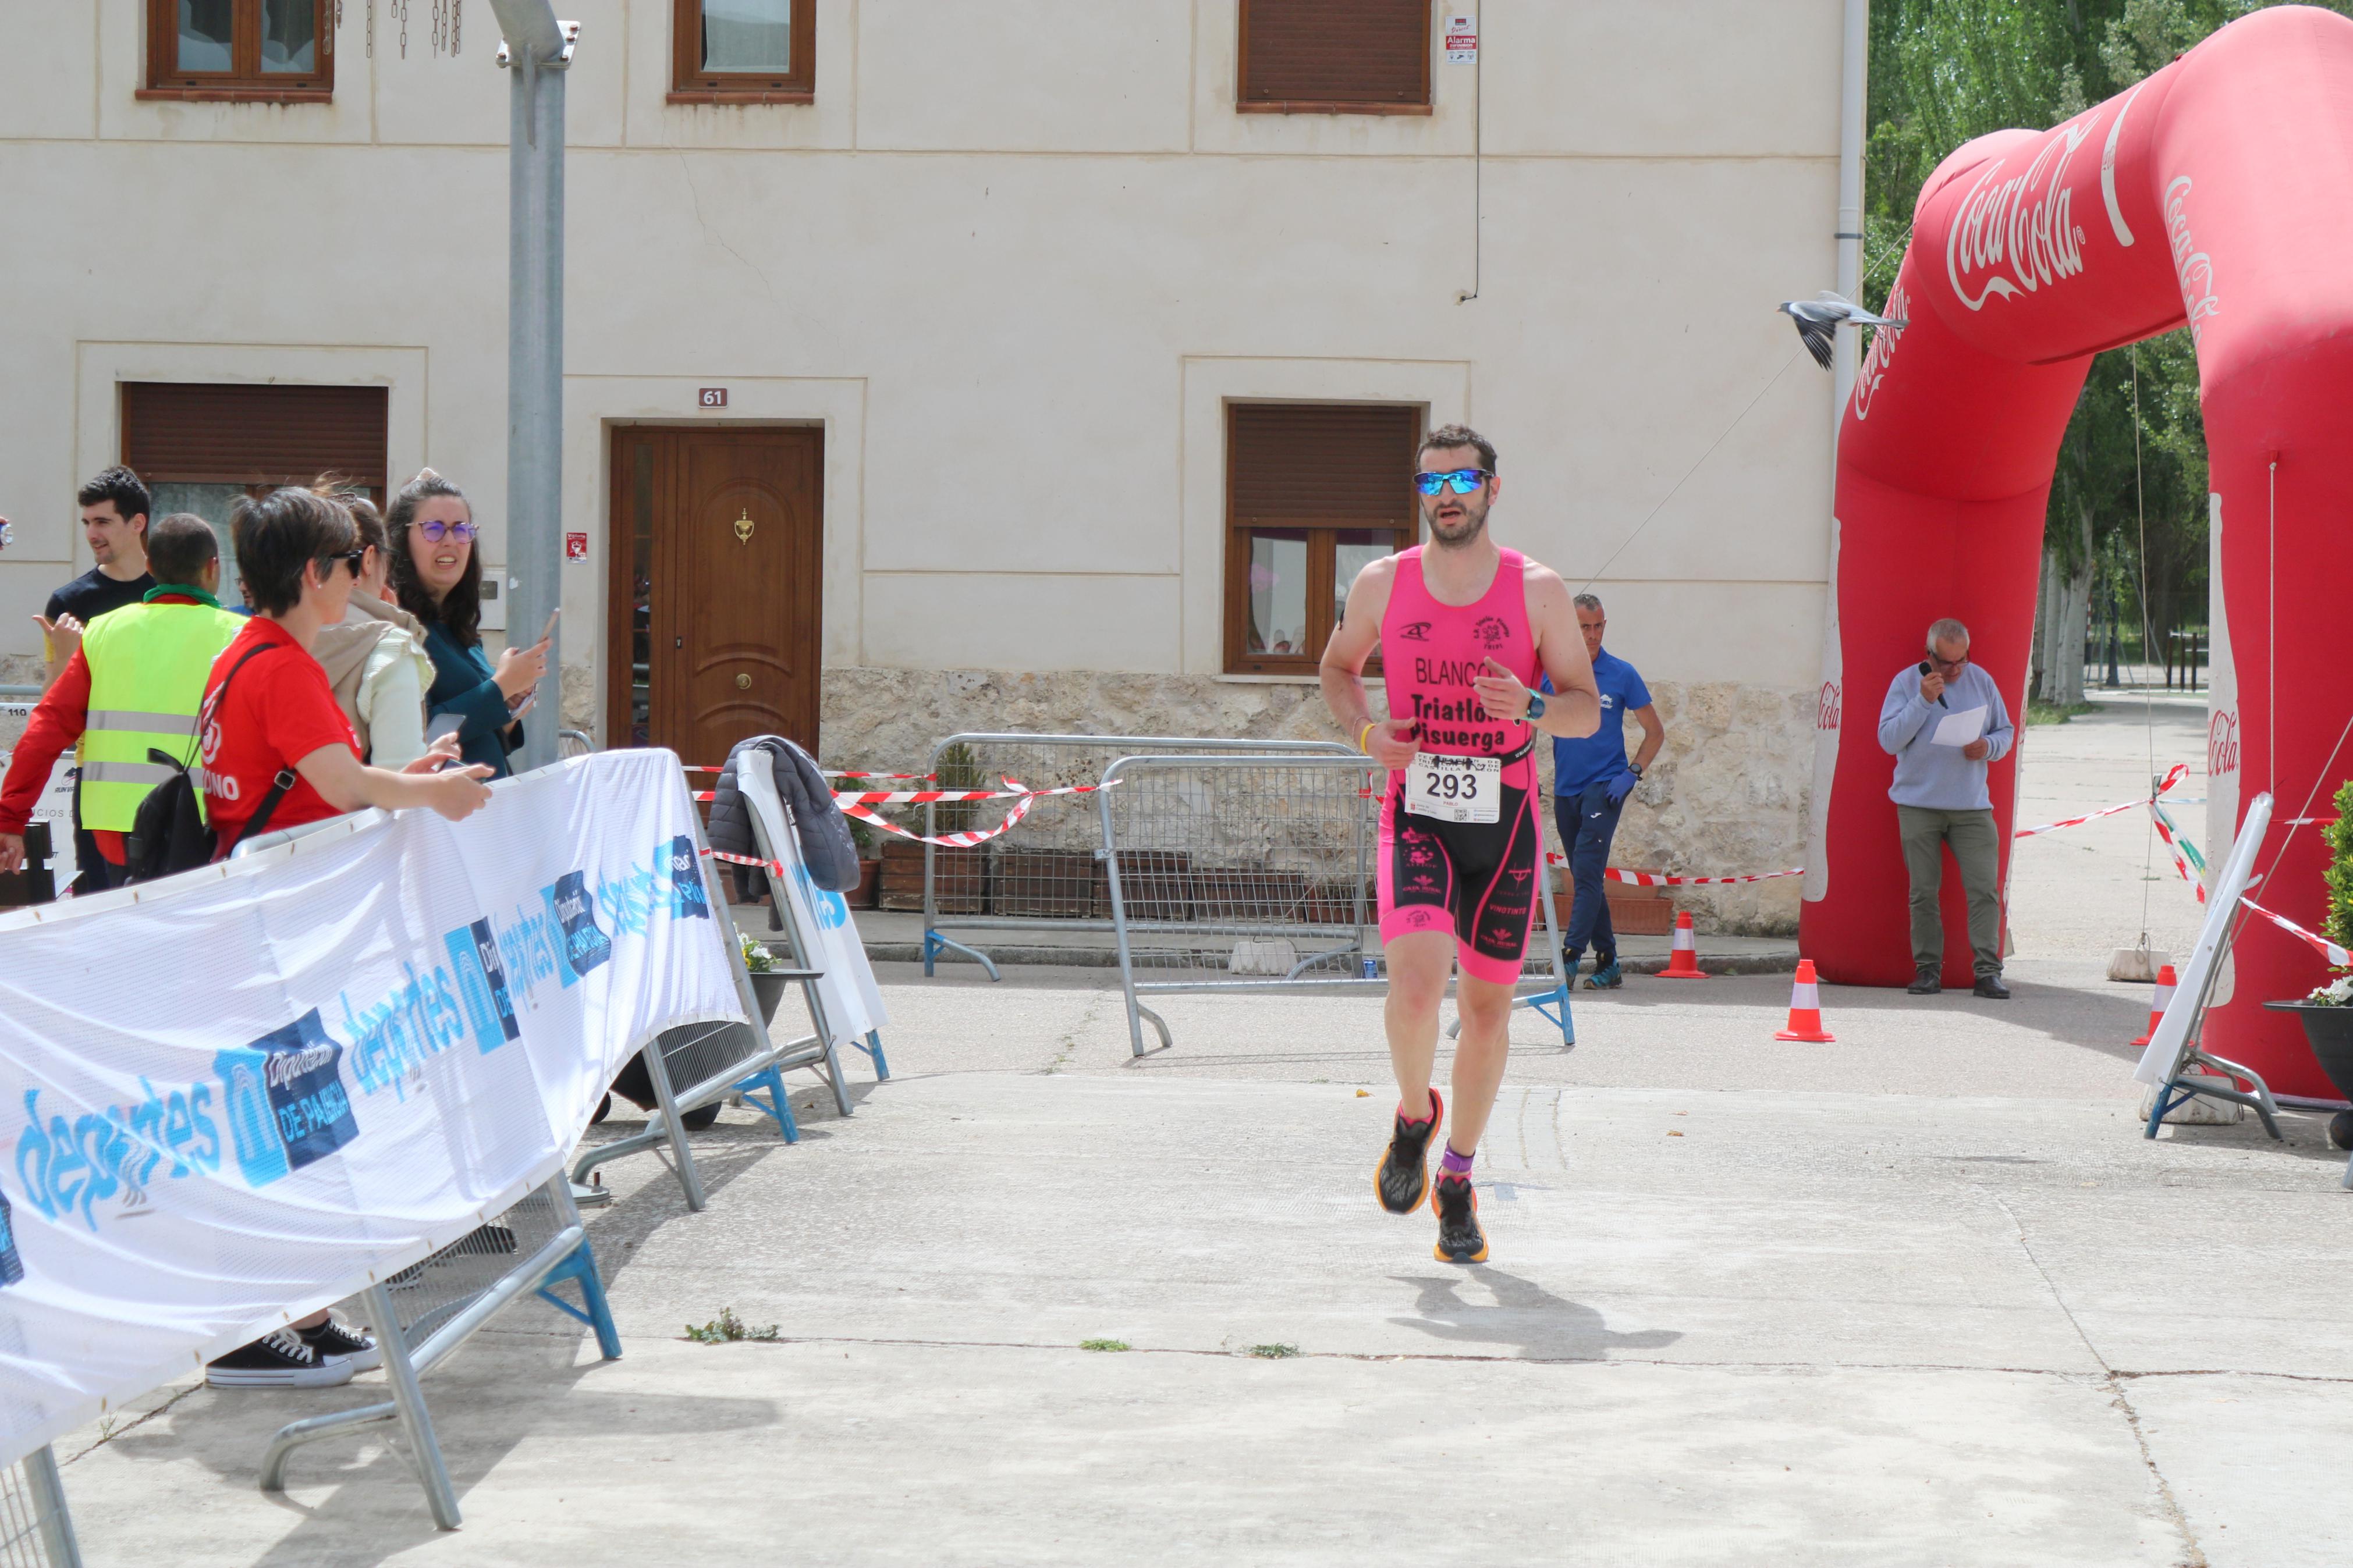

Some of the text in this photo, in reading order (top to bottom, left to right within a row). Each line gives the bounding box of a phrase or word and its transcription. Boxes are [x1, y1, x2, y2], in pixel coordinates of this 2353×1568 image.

[704, 390, 721, 404] 61
[8, 708, 27, 716] 110
[1426, 772, 1478, 800] 293
[277, 1103, 306, 1143] DE
[15, 1074, 221, 1232] deportes
